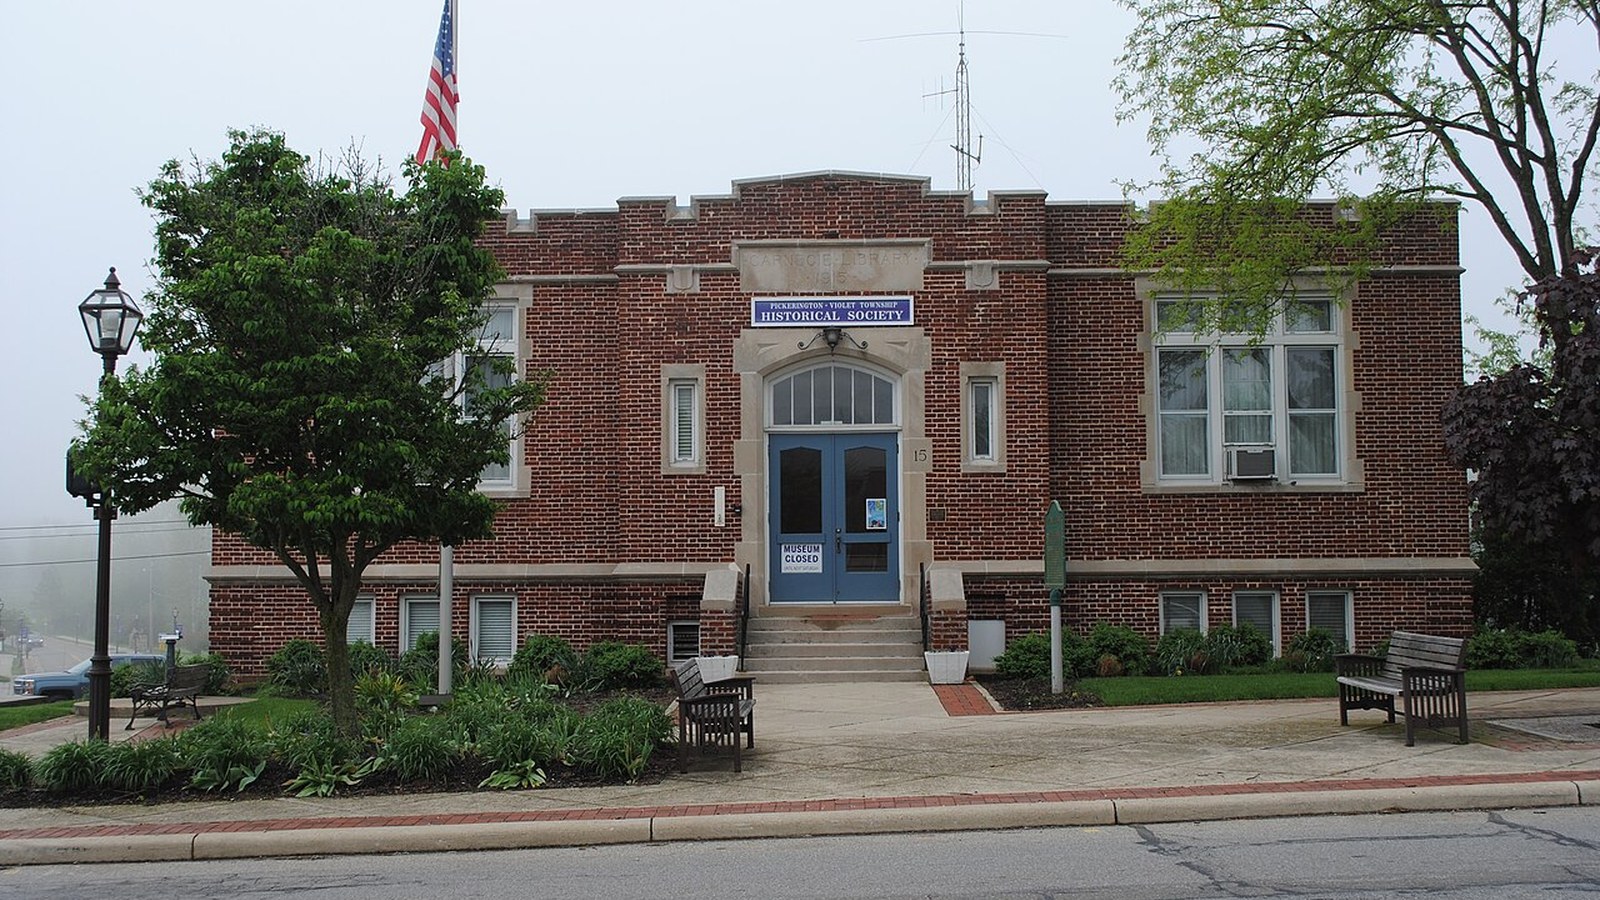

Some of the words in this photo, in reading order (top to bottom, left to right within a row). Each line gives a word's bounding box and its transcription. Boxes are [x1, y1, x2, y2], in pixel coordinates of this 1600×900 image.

[816, 271, 848, 285] 1915
[770, 302, 824, 310] PICKERINGTON
[860, 301, 898, 309] TOWNSHIP
[761, 311, 840, 322] HISTORICAL
[847, 310, 904, 321] SOCIETY
[914, 449, 928, 462] 15
[783, 544, 820, 553] MUSEUM
[784, 554, 819, 563] CLOSED
